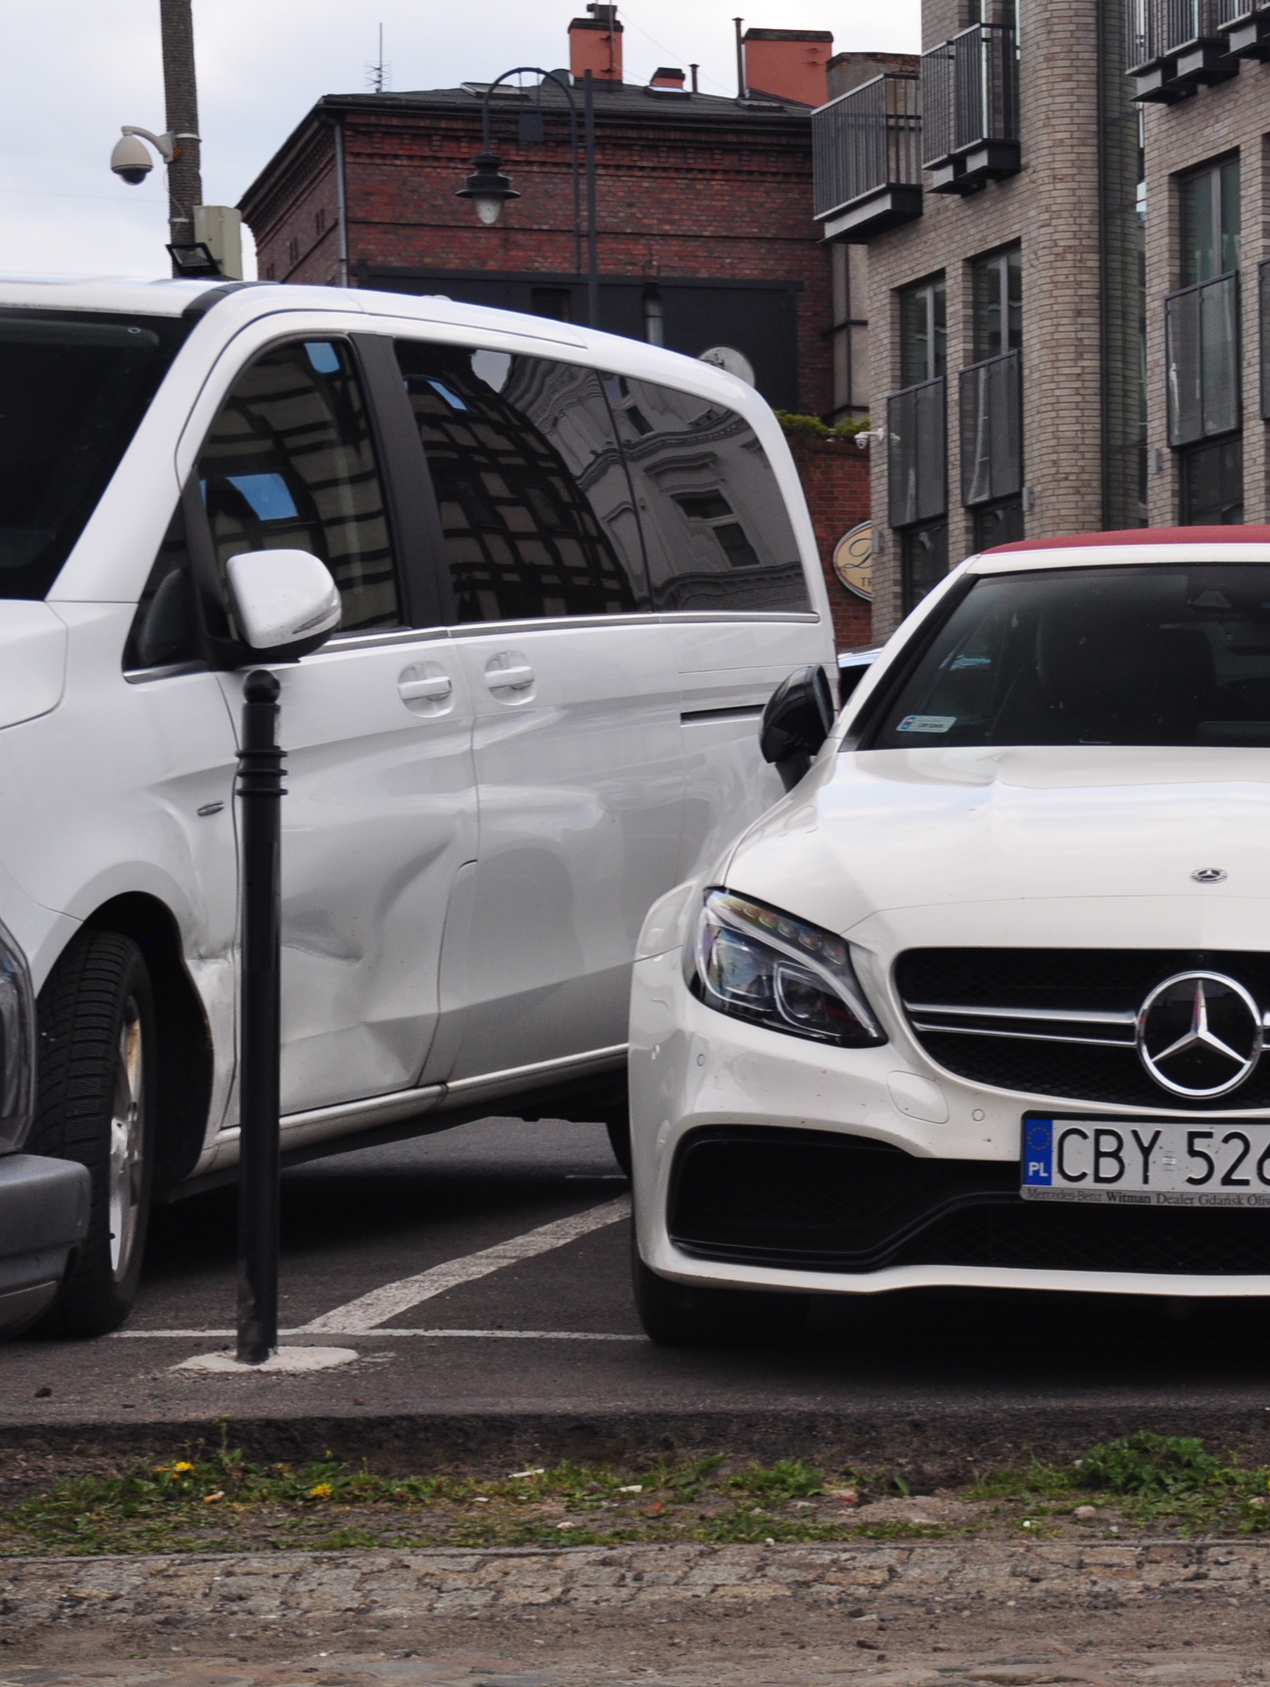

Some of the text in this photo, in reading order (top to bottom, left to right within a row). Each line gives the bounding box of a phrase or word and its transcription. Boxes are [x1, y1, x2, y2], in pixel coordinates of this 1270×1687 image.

[1057, 1127, 1162, 1185] CBY
[1028, 1161, 1049, 1177] PL
[1106, 1191, 1151, 1204] Witman
[1156, 1193, 1195, 1205] Dealer
